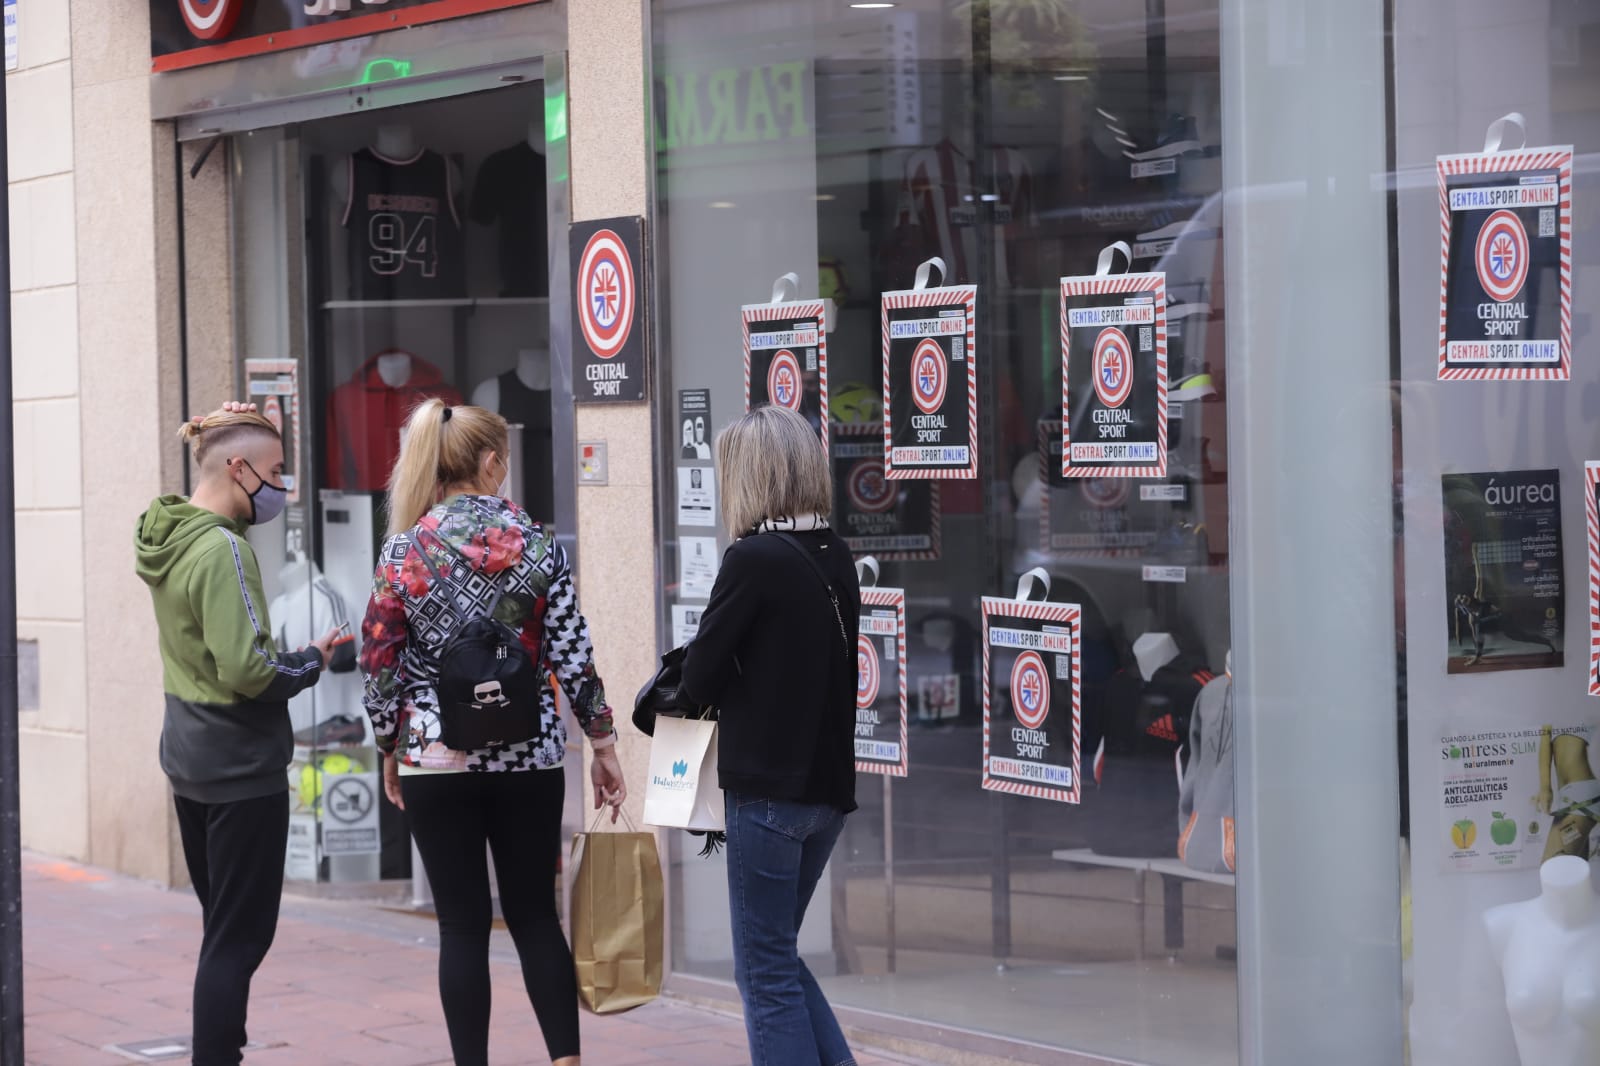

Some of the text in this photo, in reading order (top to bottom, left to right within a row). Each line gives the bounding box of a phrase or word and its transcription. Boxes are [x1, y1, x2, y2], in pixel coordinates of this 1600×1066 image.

[1452, 187, 1555, 208] CENTRALSPORT.ONLINE
[1081, 206, 1146, 223] Rakute
[368, 212, 438, 277] 94
[1071, 309, 1152, 325] CENTRALSPORT.ONLINE
[1477, 302, 1529, 320] CENTRAL
[891, 320, 963, 336] CENTRALSPORT.ONLINE
[1484, 320, 1521, 336] SPORT
[1451, 342, 1556, 360] CENTRALSPORT.ONLINE
[585, 362, 629, 381] CENTRAL
[593, 380, 621, 396] SPORT
[911, 414, 948, 429] CENTRAL
[1092, 408, 1134, 424] CENTRAL
[916, 429, 942, 444] SPORT
[1098, 424, 1128, 439] SPORT
[894, 449, 967, 463] CENTRALSPORT.ONLINE
[1073, 444, 1155, 460] CENTRALSPORT.ONLINE
[1484, 478, 1555, 506] áurea
[859, 617, 895, 633] ORT.ONLINE
[991, 629, 1068, 651] CENTRALSPORT.ONLINE
[855, 709, 881, 725] NTRAL
[854, 723, 875, 737] PORT
[1011, 727, 1050, 746] CENTRAL
[1440, 735, 1467, 744] CUANDO
[854, 741, 898, 758] SPORT.ONLINE
[1016, 743, 1045, 760] SPORT
[1511, 742, 1537, 755] SLIM
[992, 759, 1070, 784] CENTRALSPORT.ONLINE
[1464, 758, 1515, 769] naturalmente
[1444, 782, 1509, 796] ANTICELULÍTICAS
[1444, 792, 1503, 805] ADELGAZANTES
